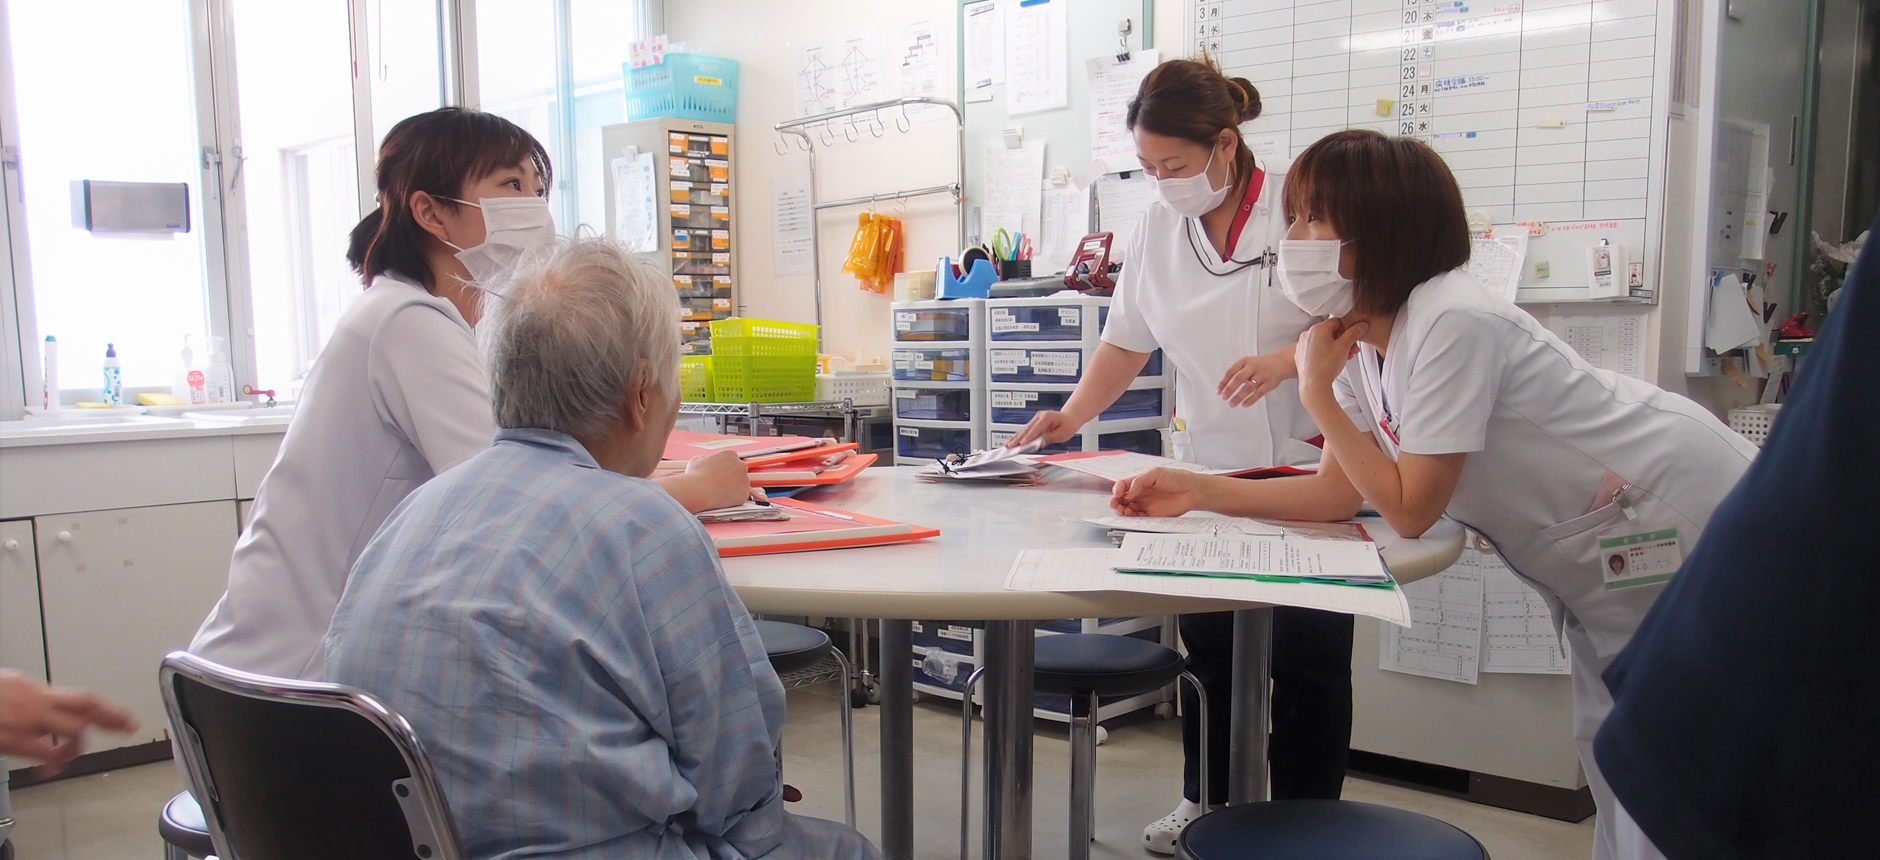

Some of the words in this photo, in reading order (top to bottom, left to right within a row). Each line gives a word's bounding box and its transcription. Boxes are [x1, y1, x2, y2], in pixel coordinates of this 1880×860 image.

[1200, 7, 1205, 19] 3
[1211, 8, 1218, 16] 月
[1405, 10, 1417, 24] 20
[1423, 11, 1432, 20] 木
[1199, 25, 1205, 36] 4
[1404, 30, 1415, 43] 21
[1422, 30, 1432, 40] 金
[1404, 48, 1416, 61] 22
[1423, 48, 1431, 57] 土
[1403, 67, 1415, 80] 23
[1403, 85, 1415, 97] 24
[1420, 85, 1429, 94] 月
[1402, 103, 1414, 116] 25
[1420, 103, 1428, 112] 火
[1401, 122, 1414, 134] 26
[1419, 122, 1427, 131] 水
